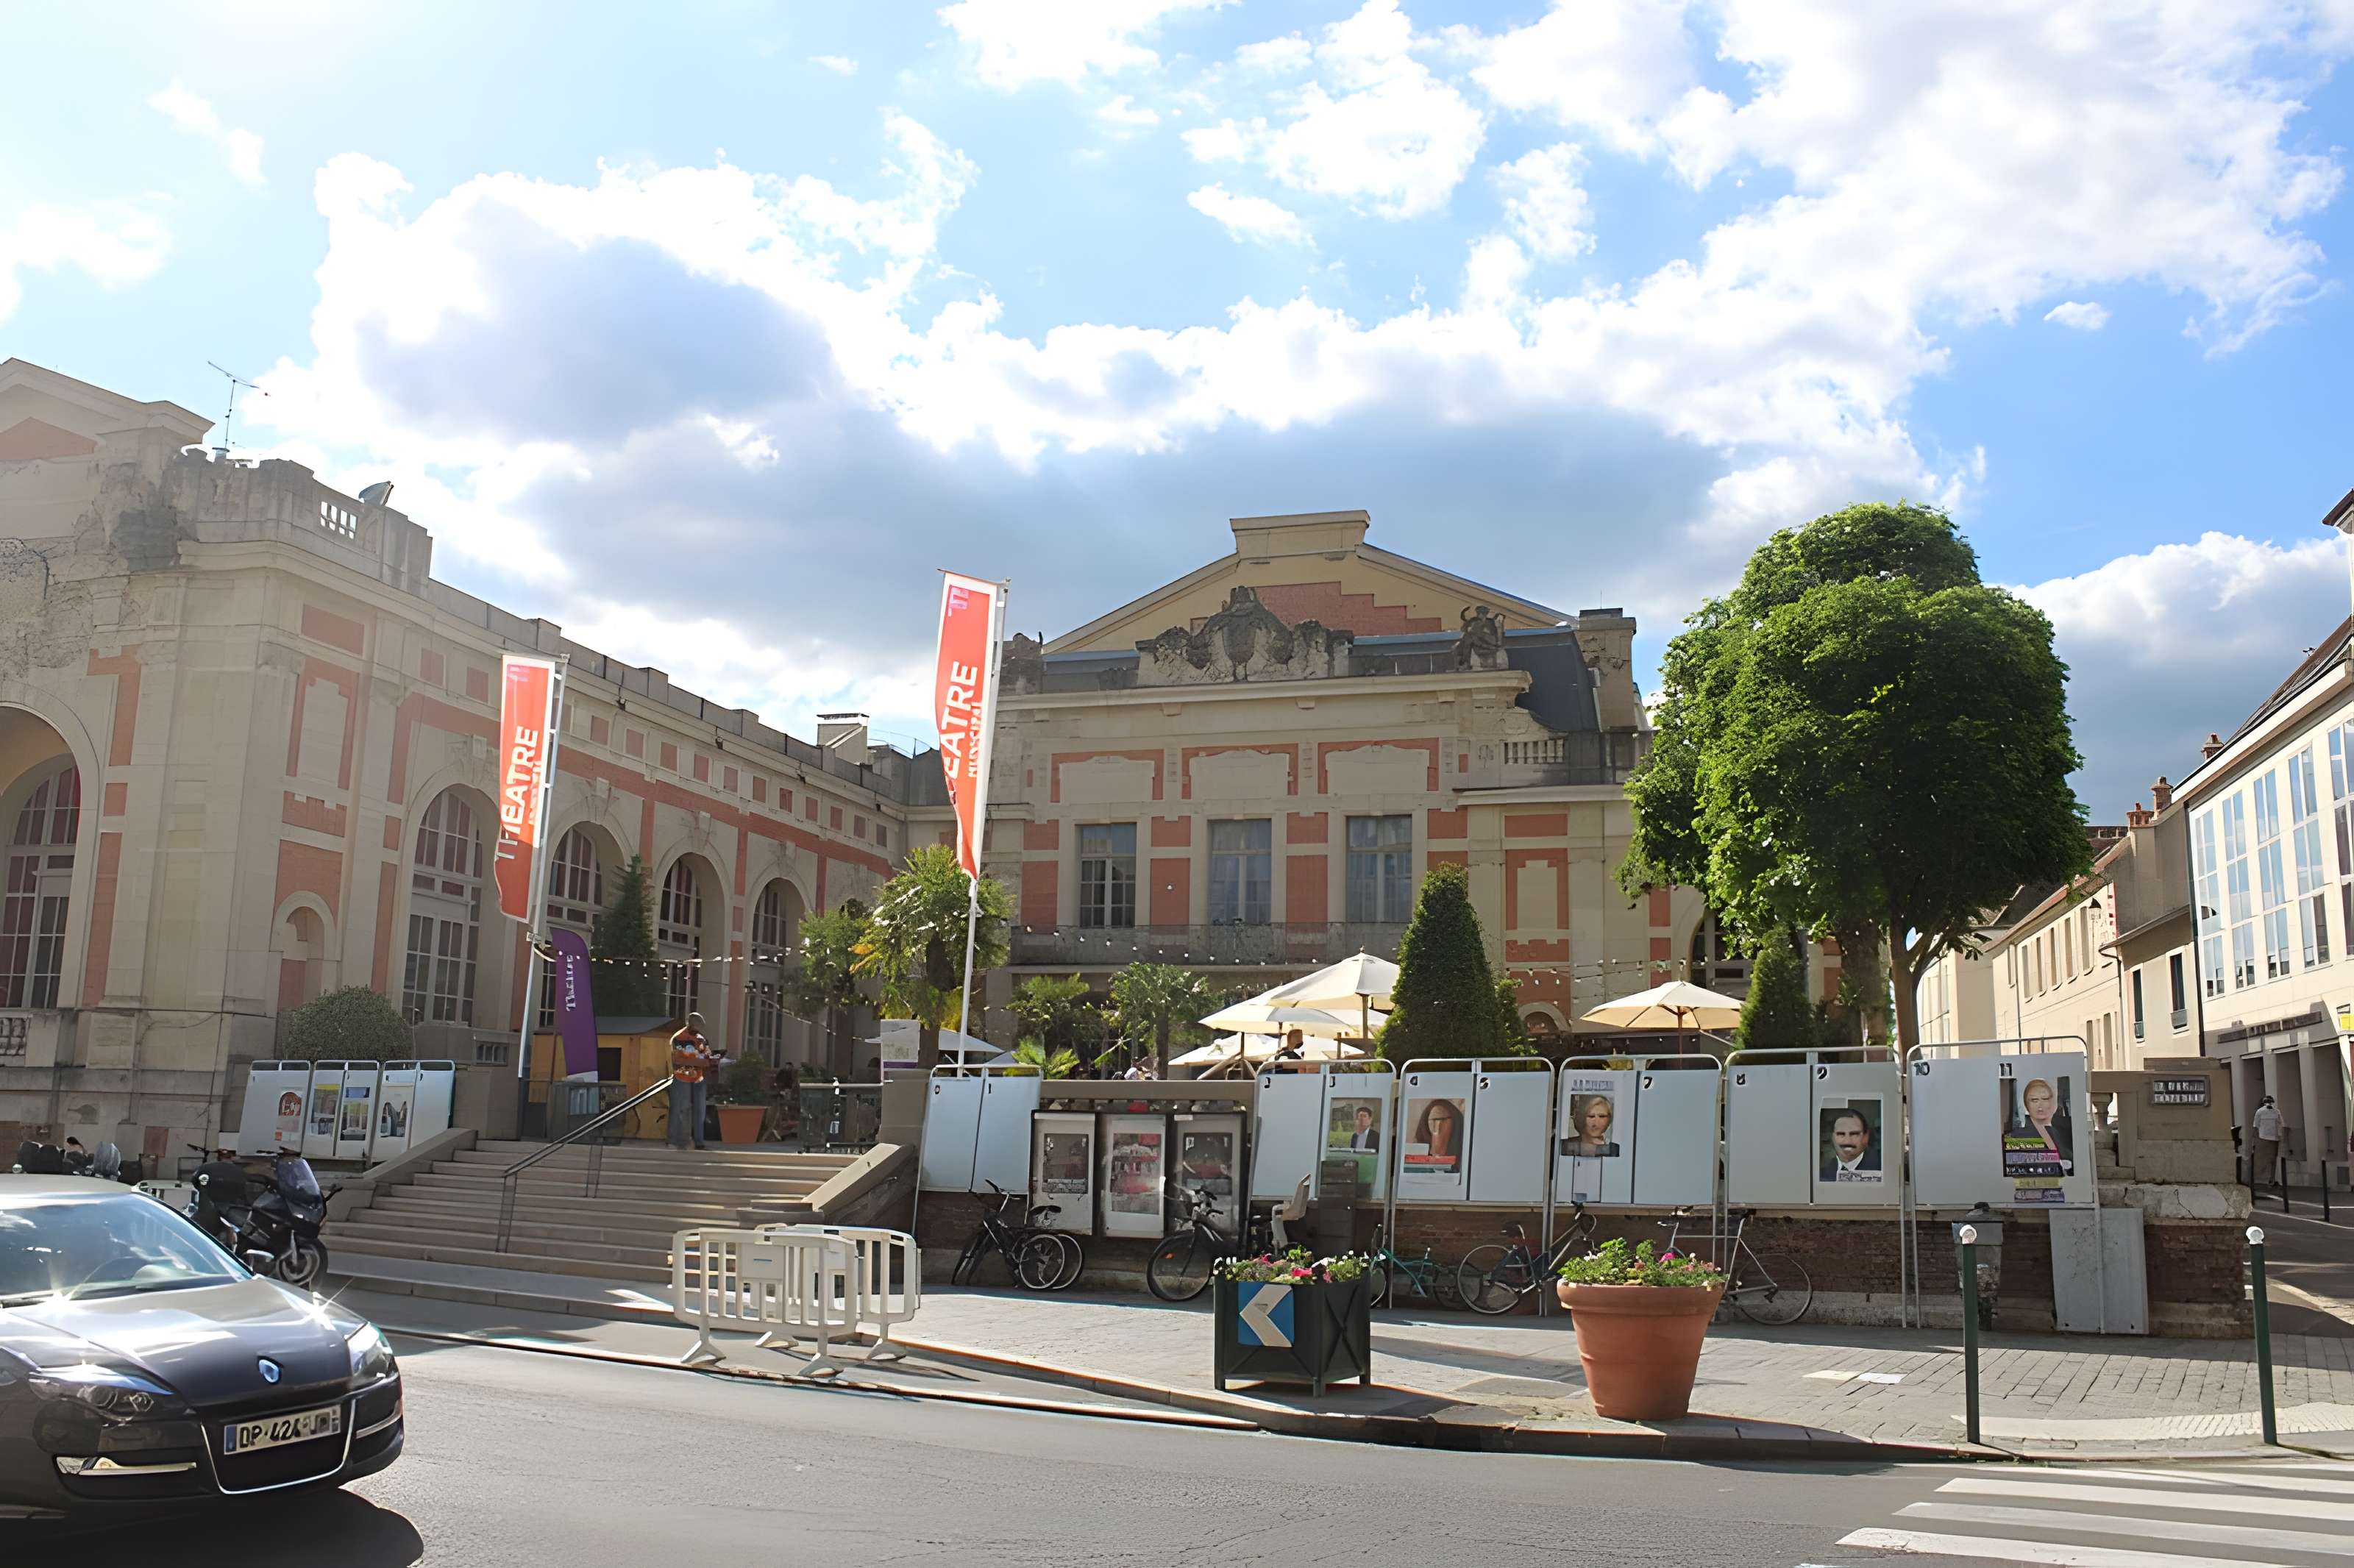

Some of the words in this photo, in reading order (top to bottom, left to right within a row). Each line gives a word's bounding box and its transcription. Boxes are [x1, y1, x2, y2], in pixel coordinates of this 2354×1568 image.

[940, 661, 978, 780] EATRE
[1913, 1061, 1930, 1076] 10
[1999, 1063, 2013, 1077] 11
[1643, 1076, 1653, 1089] 7
